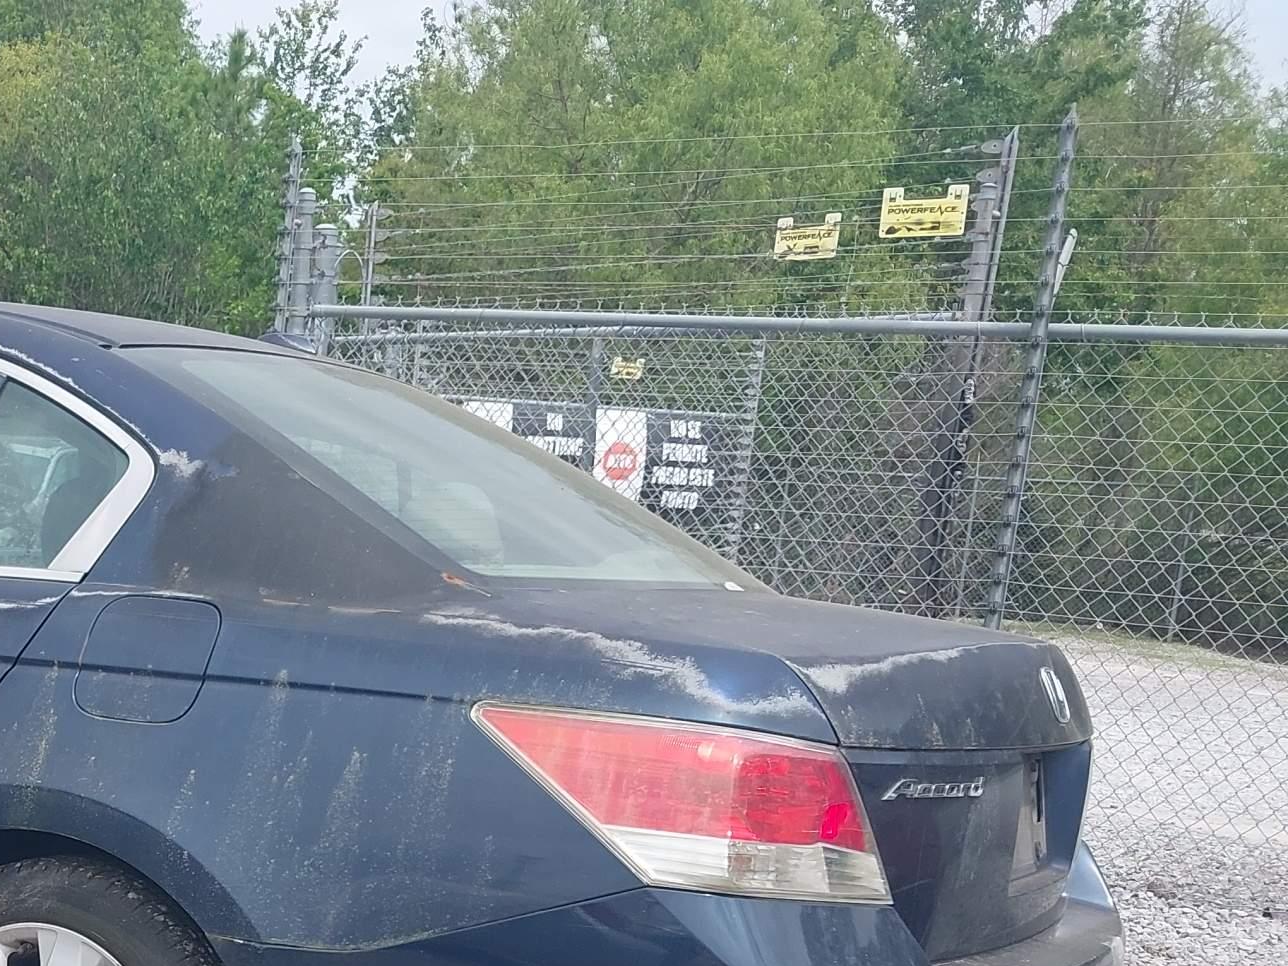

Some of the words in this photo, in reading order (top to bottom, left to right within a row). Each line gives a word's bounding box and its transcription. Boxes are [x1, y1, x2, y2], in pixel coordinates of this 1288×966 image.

[546, 412, 563, 430] NO
[670, 420, 686, 437] NO
[687, 421, 701, 438] SE
[881, 776, 985, 800] Accord
